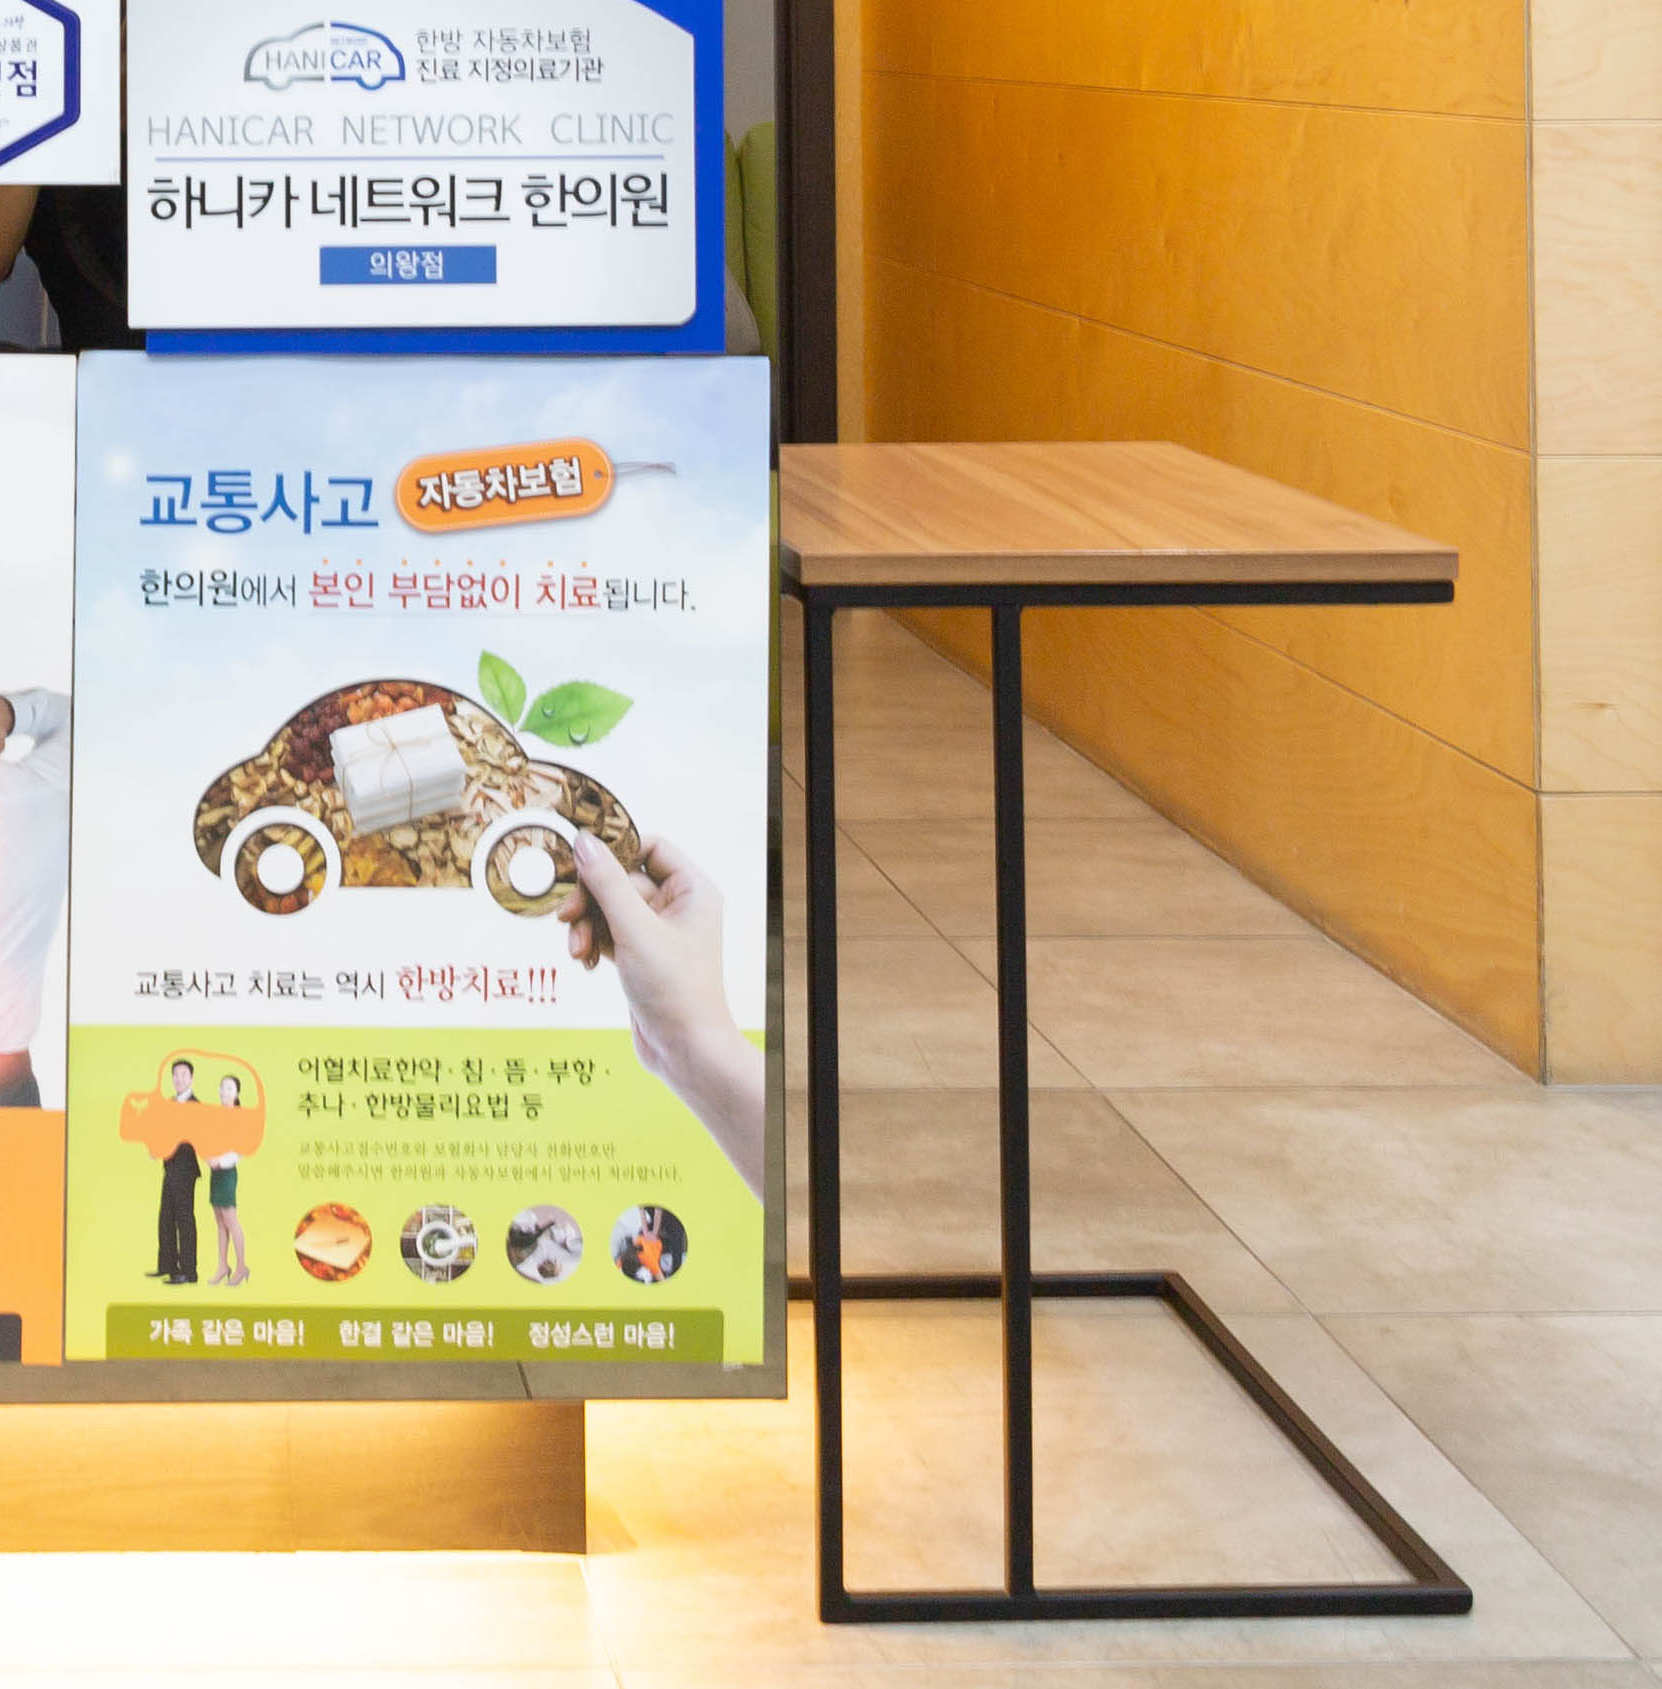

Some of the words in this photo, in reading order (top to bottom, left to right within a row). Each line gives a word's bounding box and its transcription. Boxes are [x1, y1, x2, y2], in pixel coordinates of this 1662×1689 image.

[415, 28, 463, 55] 한방
[473, 27, 592, 55] 자동차보험
[416, 57, 460, 83] 진료
[468, 56, 605, 83] 지정의료기관
[147, 114, 315, 147] HANICAR
[342, 113, 523, 145] NETWORK
[550, 113, 675, 144] CLINIC
[147, 174, 300, 230] 하니카
[311, 173, 511, 229] 네트워크
[521, 171, 669, 229] 한의원
[369, 250, 445, 280] 의왕점
[140, 469, 379, 535] 교통사고
[419, 456, 583, 513] 자동차보험
[140, 569, 297, 609] 한의원에서
[309, 572, 375, 609] 본인
[388, 572, 521, 611] 부담없이
[536, 574, 697, 612] 치료됩니다.
[134, 970, 238, 1002] 교통사고
[247, 969, 325, 1002] 치료는
[336, 969, 386, 1002] 역시
[397, 965, 559, 1006] 한방치료!!!
[366, 1092, 509, 1120] 한방물리요법
[521, 1093, 543, 1120] 등
[150, 1318, 193, 1346] 가족
[202, 1319, 244, 1346] 같은
[253, 1319, 304, 1346] 마음!
[339, 1319, 382, 1347] 한결
[391, 1320, 436, 1347] 같은
[442, 1320, 494, 1348] 마음!
[529, 1321, 614, 1349] 정성스런
[623, 1320, 675, 1348] 마음!
